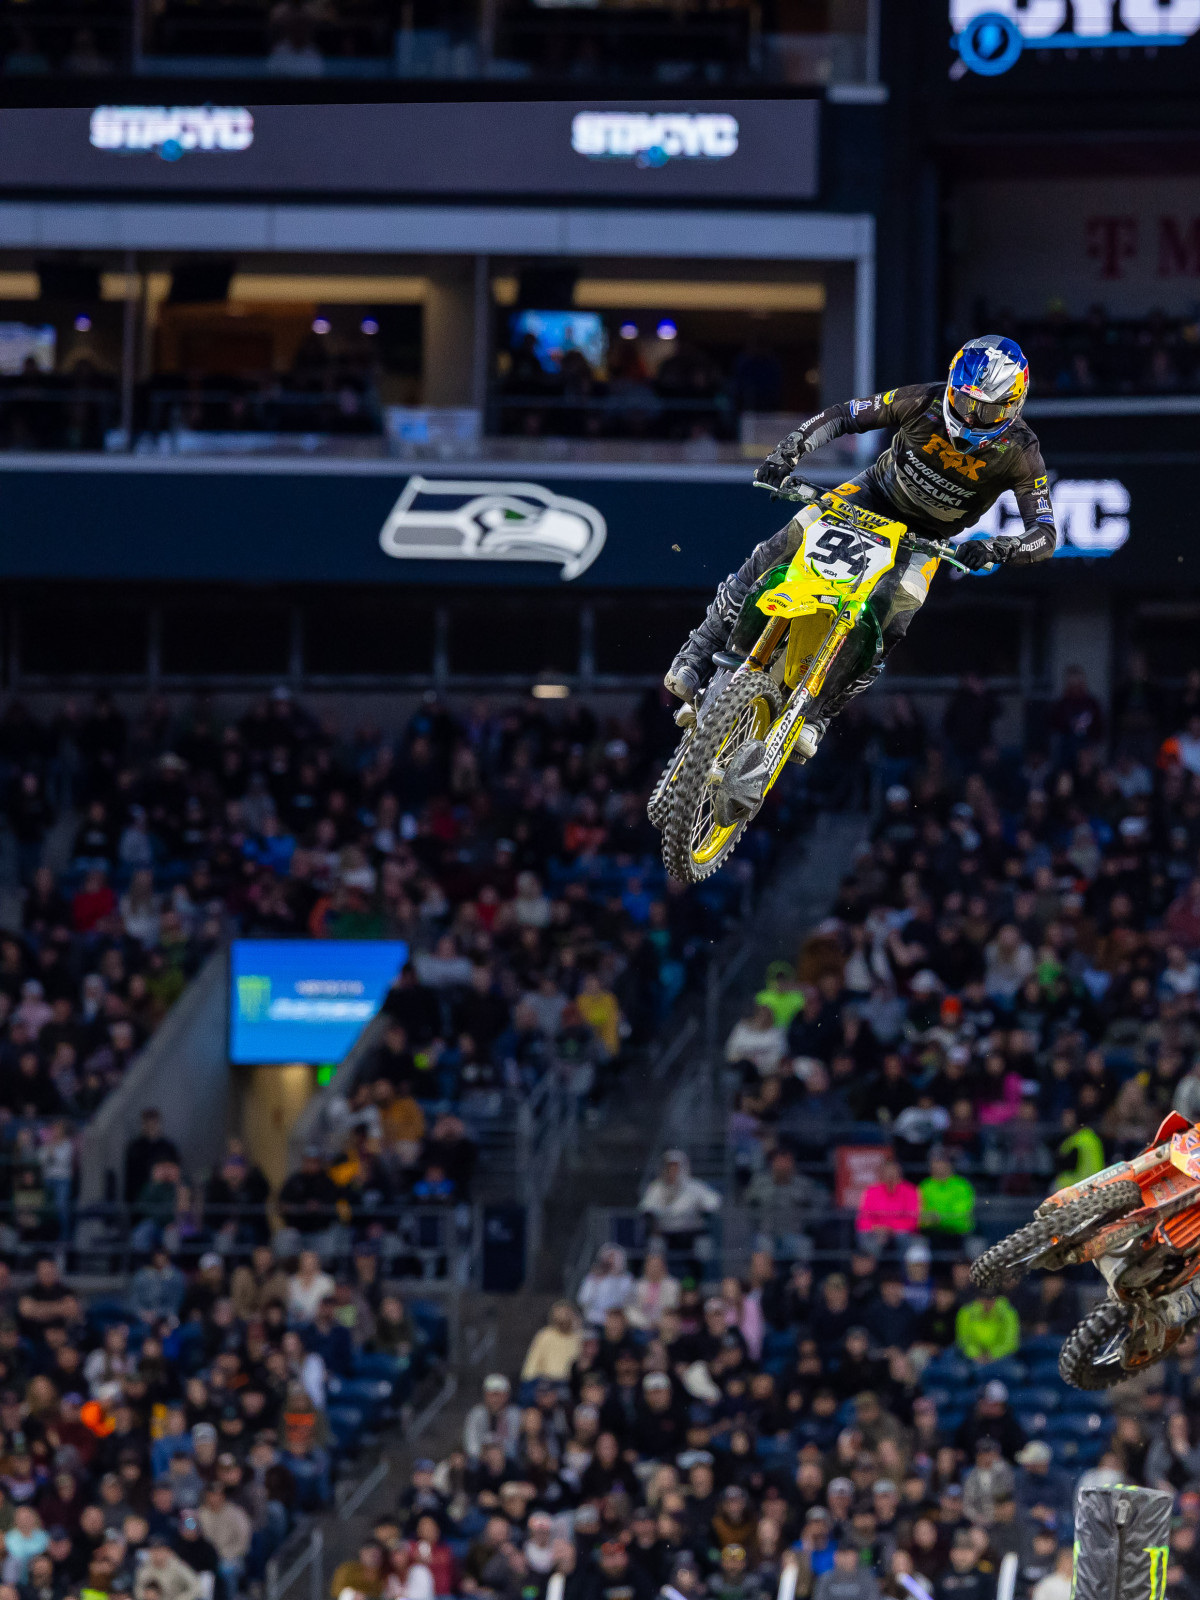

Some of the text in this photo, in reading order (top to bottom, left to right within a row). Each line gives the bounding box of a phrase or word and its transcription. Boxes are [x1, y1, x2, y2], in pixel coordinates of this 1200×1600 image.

[903, 463, 963, 507] SUZUKI
[905, 450, 977, 498] PROGRESSIVE
[805, 529, 876, 577] 94
[762, 711, 793, 769] DUNLOP
